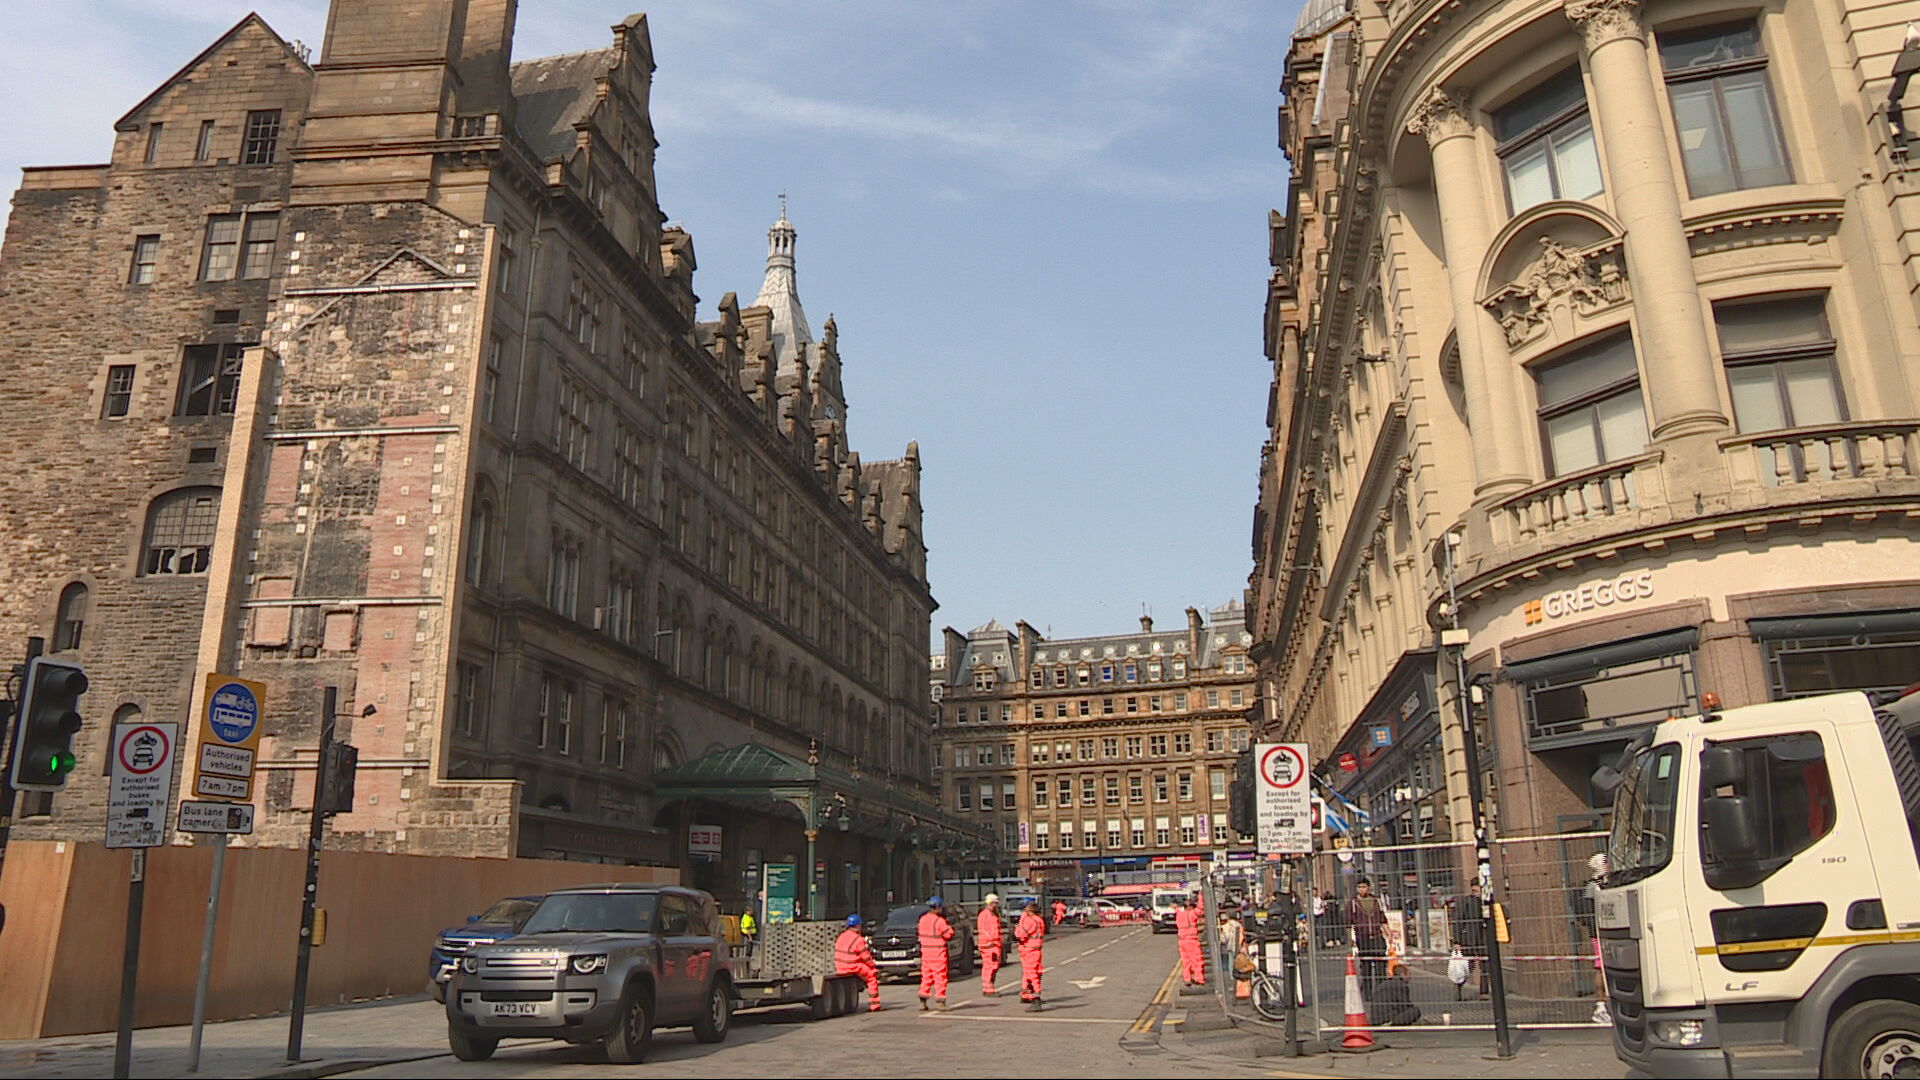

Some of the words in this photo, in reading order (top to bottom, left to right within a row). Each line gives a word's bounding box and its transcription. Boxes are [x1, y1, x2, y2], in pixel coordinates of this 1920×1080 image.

[1545, 573, 1654, 618] GREGGS
[223, 727, 239, 738] taxi
[205, 748, 250, 762] Authorised
[210, 761, 243, 771] vehicles
[184, 806, 201, 815] Bus
[204, 806, 224, 817] lane
[1300, 810, 1308, 818] by
[1725, 981, 1759, 992] LF
[494, 1003, 517, 1013] AK73
[519, 1003, 537, 1013] VCV
